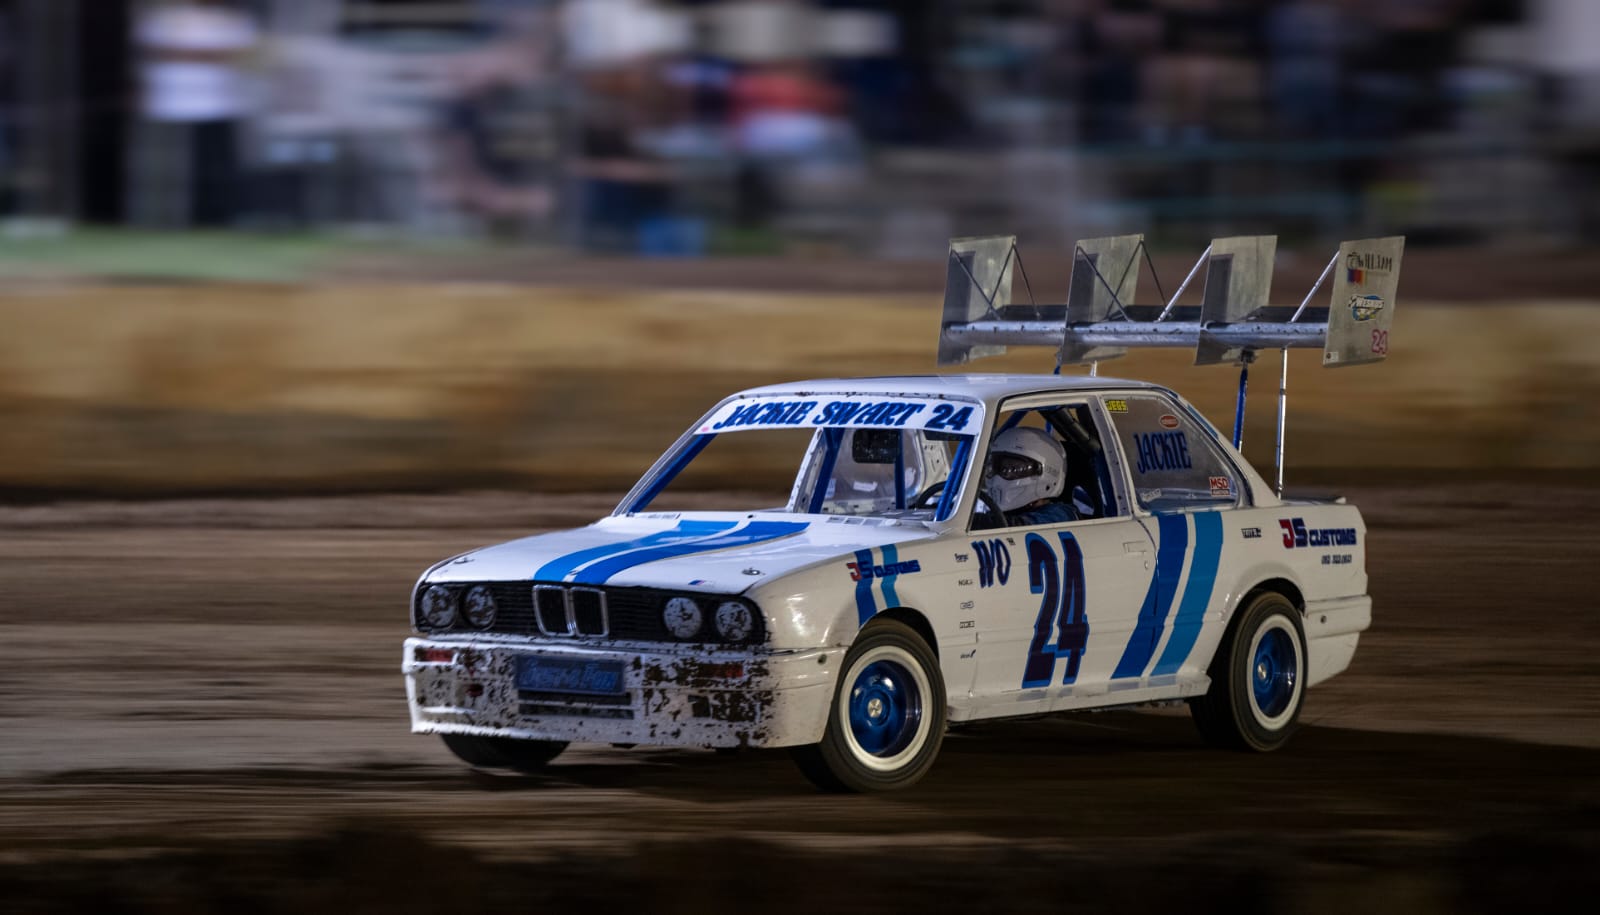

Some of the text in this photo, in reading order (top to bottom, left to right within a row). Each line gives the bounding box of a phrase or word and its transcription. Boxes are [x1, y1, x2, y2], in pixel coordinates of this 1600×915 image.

[1371, 328, 1388, 355] 24
[713, 401, 974, 431] JACKIE SWART 24
[1133, 431, 1192, 474] JACKIE
[1279, 518, 1308, 549] JS
[1309, 528, 1357, 546] CUSTOMS
[1021, 531, 1090, 689] 24
